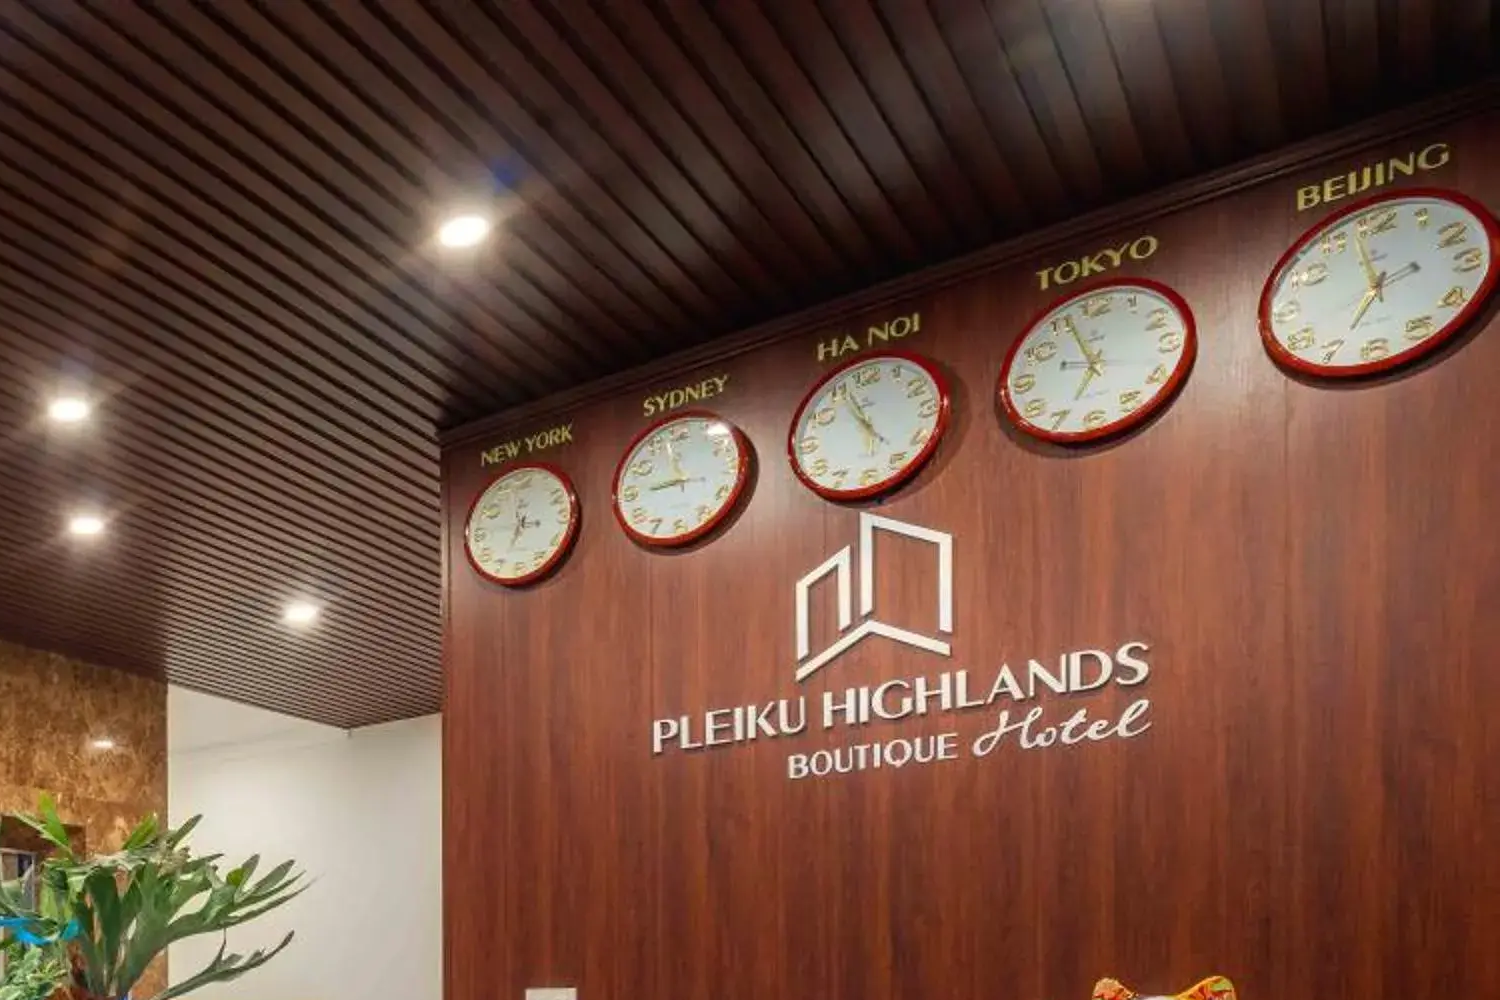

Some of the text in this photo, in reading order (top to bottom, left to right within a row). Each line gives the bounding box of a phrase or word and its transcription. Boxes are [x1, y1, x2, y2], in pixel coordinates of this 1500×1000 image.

[1297, 143, 1450, 211] BEIJING
[1356, 207, 1398, 238] 12
[1414, 208, 1429, 227] 1
[1320, 231, 1348, 256] 11
[1436, 222, 1467, 250] 2
[1036, 235, 1158, 290] TOKYO
[1453, 248, 1482, 273] 3
[1291, 262, 1328, 289] 10
[1079, 297, 1111, 318] 12
[1127, 295, 1137, 314] 1
[1438, 287, 1466, 308] 4
[1146, 308, 1168, 331] 2
[1274, 301, 1298, 323] 9
[817, 312, 920, 361] HA NOI
[1051, 314, 1072, 336] 11
[1405, 316, 1437, 341] 5
[1025, 341, 1057, 366] 10
[1159, 332, 1181, 353] 3
[1321, 338, 1344, 363] 7
[1361, 338, 1389, 360] 6
[1014, 374, 1036, 394] 9
[1146, 363, 1167, 385] 4
[643, 374, 729, 417] SYDNEY
[1119, 390, 1141, 412] 5
[1024, 398, 1046, 418] 8
[1052, 409, 1071, 431] 7
[1083, 410, 1106, 428] 6
[481, 424, 573, 466] NEW YORK
[653, 642, 1151, 753] PLEIKU HIGHLANDS
[788, 699, 1153, 779] BOUTIQUE Hotel
